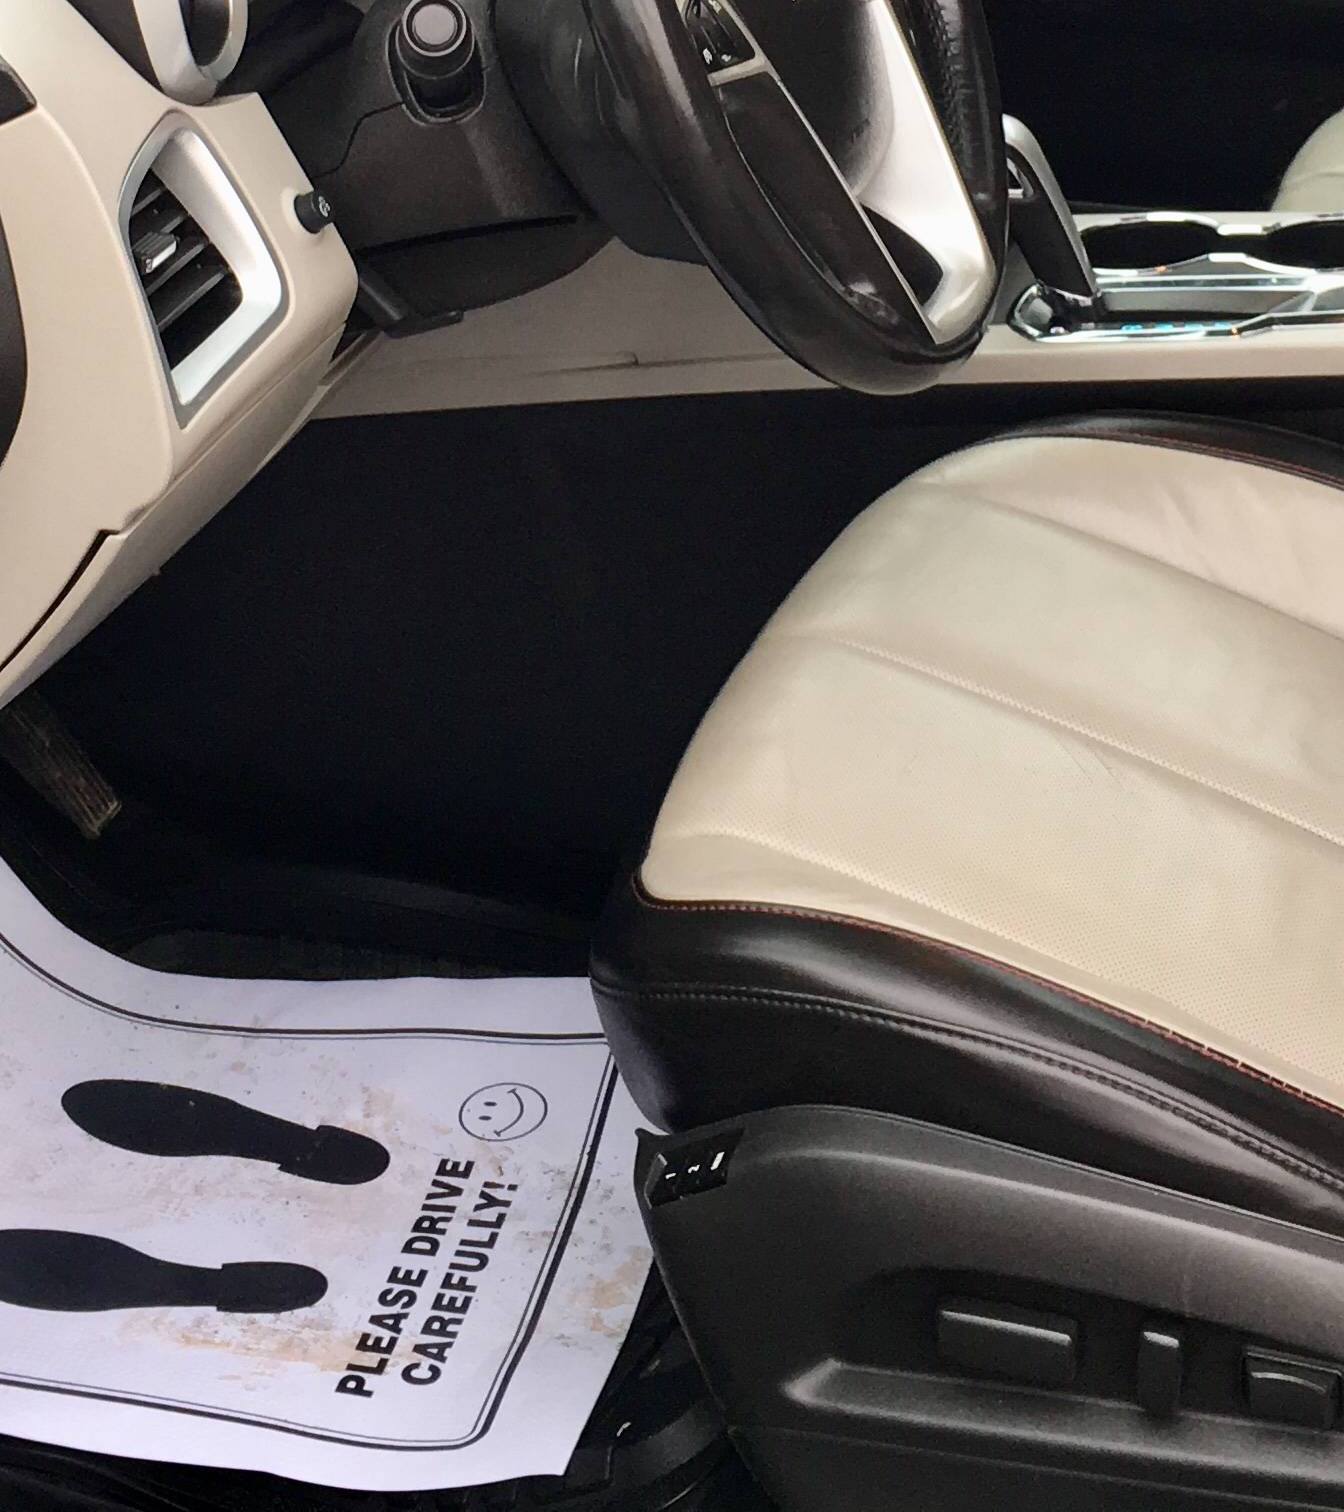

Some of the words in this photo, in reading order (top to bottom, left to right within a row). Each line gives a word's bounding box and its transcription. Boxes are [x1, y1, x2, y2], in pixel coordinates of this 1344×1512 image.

[334, 1265, 429, 1399] PLEASE
[400, 1157, 475, 1257] DRIVE
[400, 1180, 518, 1386] CAREFULLY!
